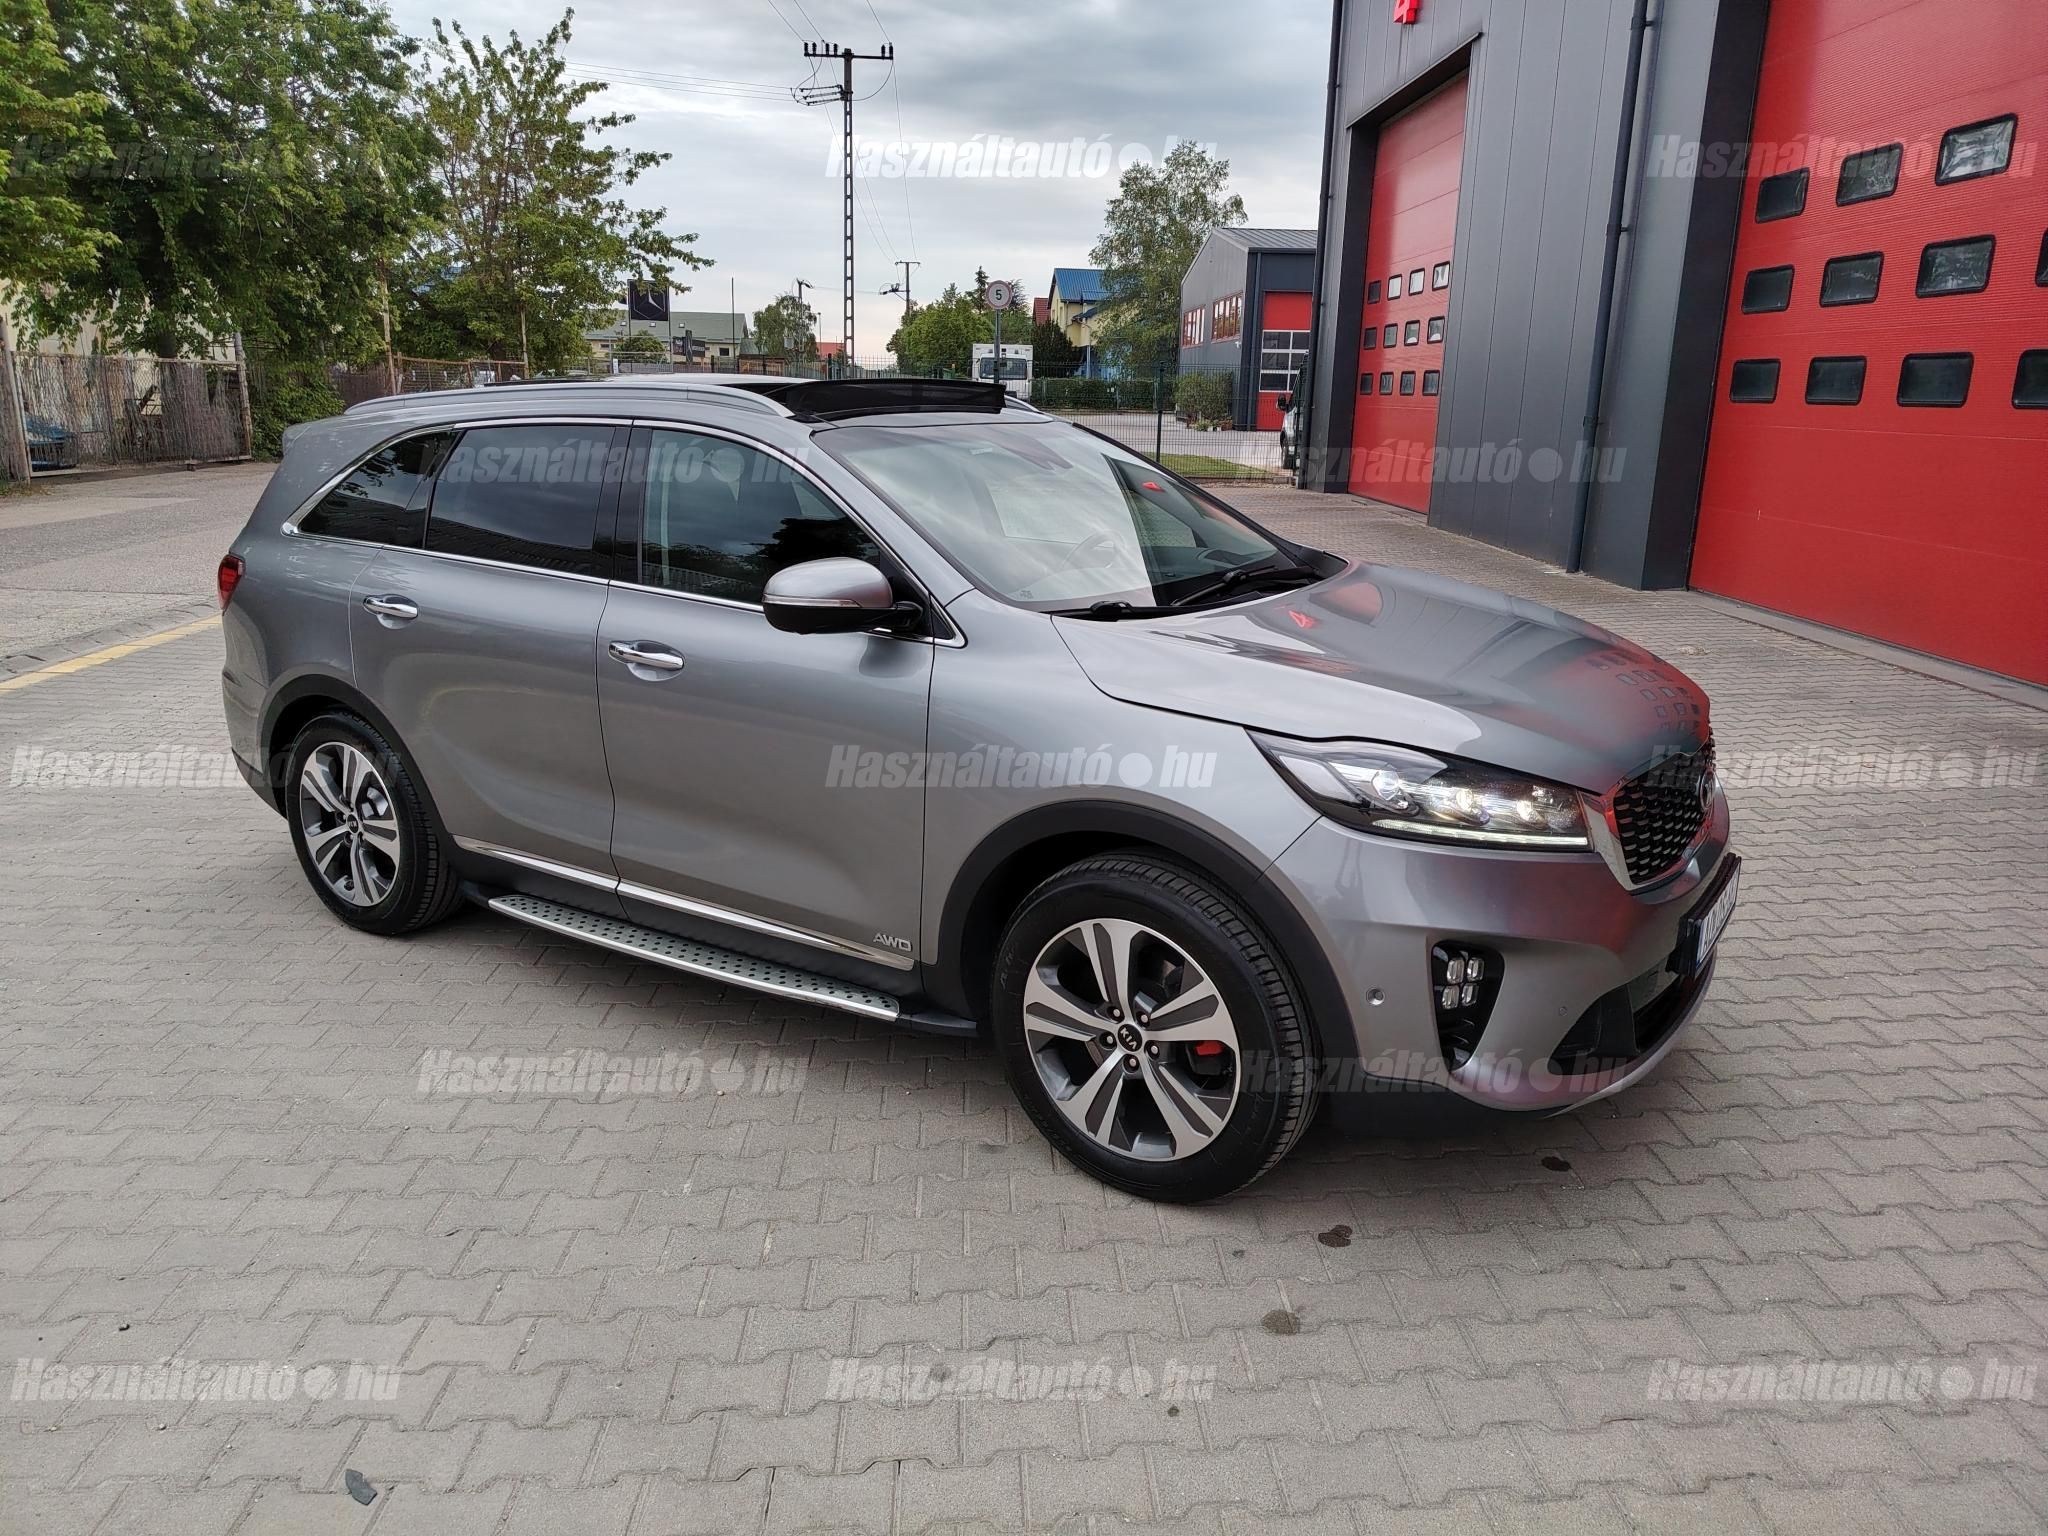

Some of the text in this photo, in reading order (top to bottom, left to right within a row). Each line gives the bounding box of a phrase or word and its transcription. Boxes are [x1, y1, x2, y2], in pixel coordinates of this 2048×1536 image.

[995, 289, 1003, 301] 5
[872, 932, 912, 952] AWD
[1120, 1027, 1137, 1050] KIA
